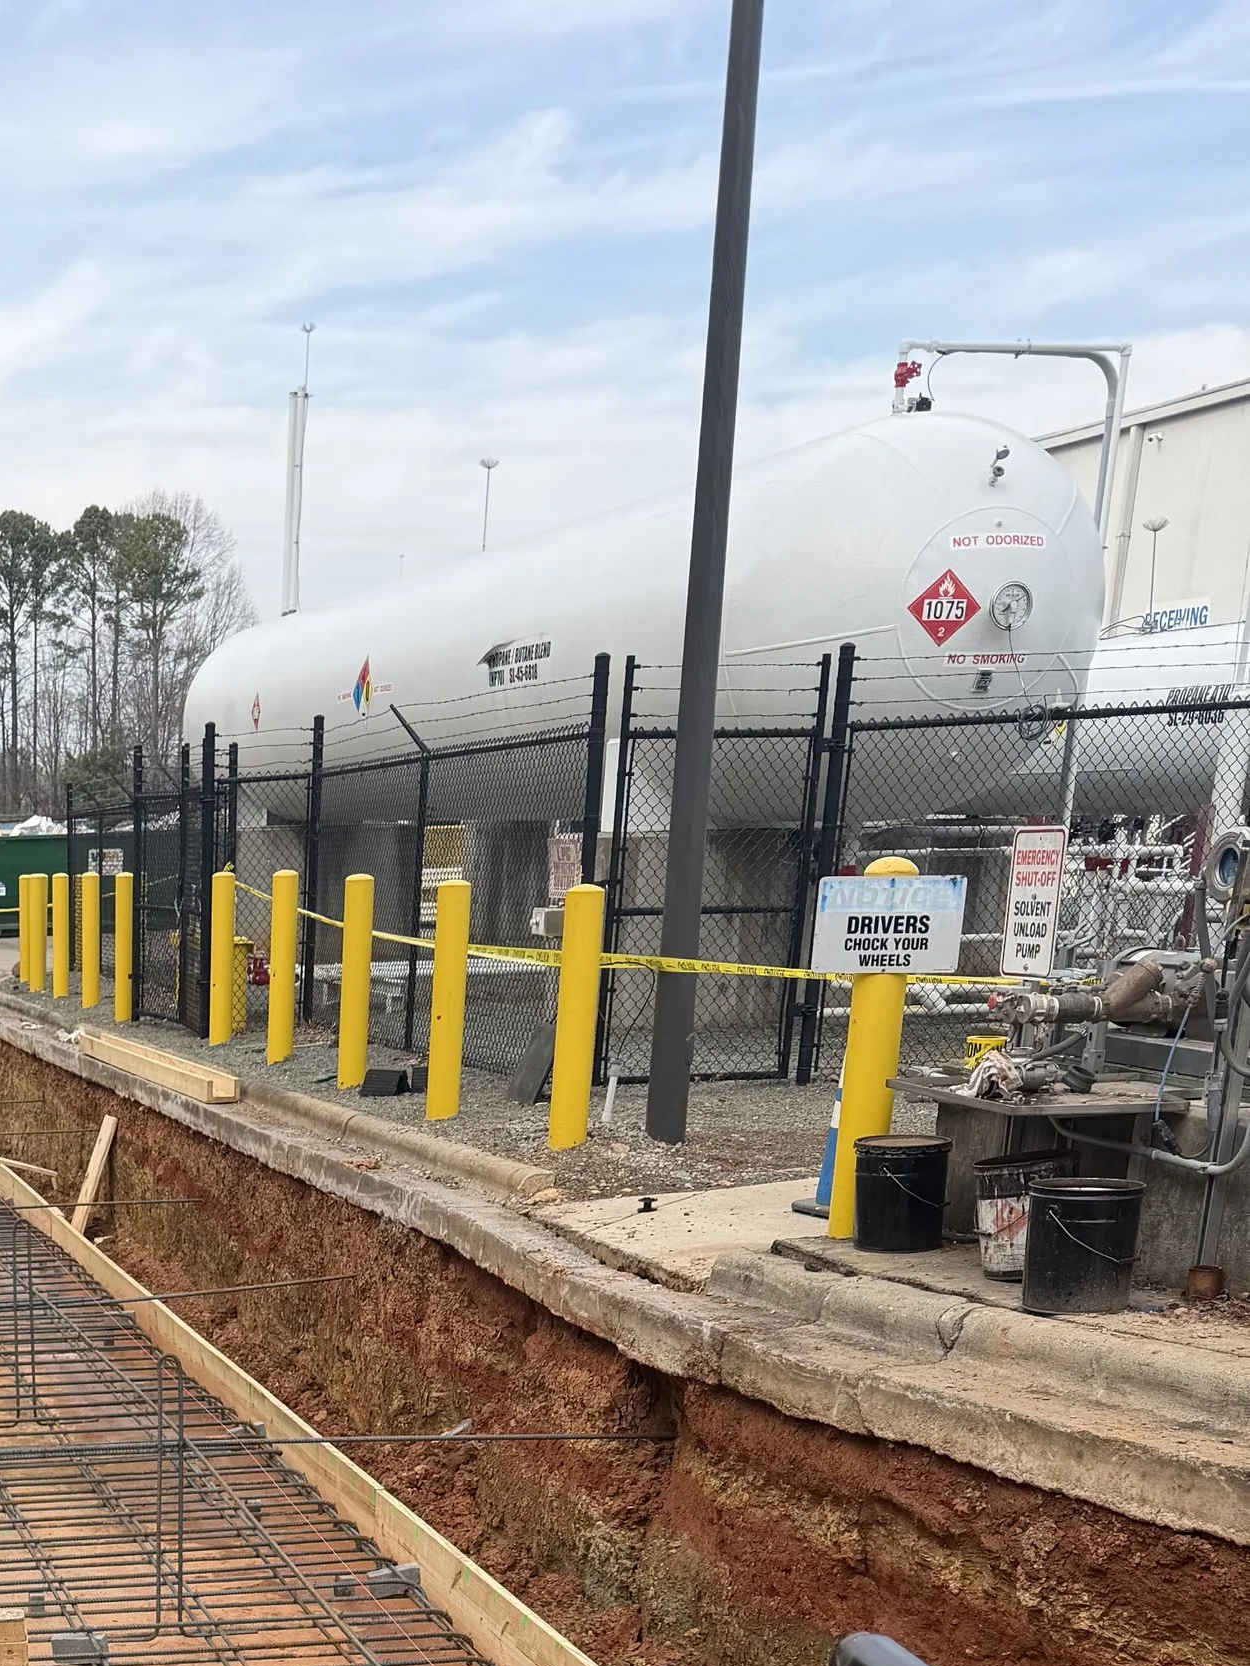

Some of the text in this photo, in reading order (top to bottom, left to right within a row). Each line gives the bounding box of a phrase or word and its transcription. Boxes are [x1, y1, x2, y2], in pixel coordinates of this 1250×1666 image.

[952, 535, 1044, 547] NOT ODORIZED
[926, 600, 965, 620] 1075
[1145, 605, 1209, 630] RECEIVING
[937, 627, 945, 637] 2
[515, 644, 535, 664] BUTANE
[534, 641, 551, 660] BLEND
[947, 653, 1025, 665] NO SMOKING
[1166, 685, 1212, 706] PROPANE
[1016, 849, 1060, 866] EMERGENCY
[1015, 871, 1057, 887] SHUT-OFF
[830, 887, 950, 906] NOTICE
[1013, 900, 1052, 917] SOLVENT
[846, 915, 931, 935] DRIVERS
[1013, 922, 1047, 938] UNLOAD
[844, 937, 929, 951] CHOCK YOUR
[1015, 943, 1041, 959] PUMP
[859, 953, 912, 967] WHEELS
